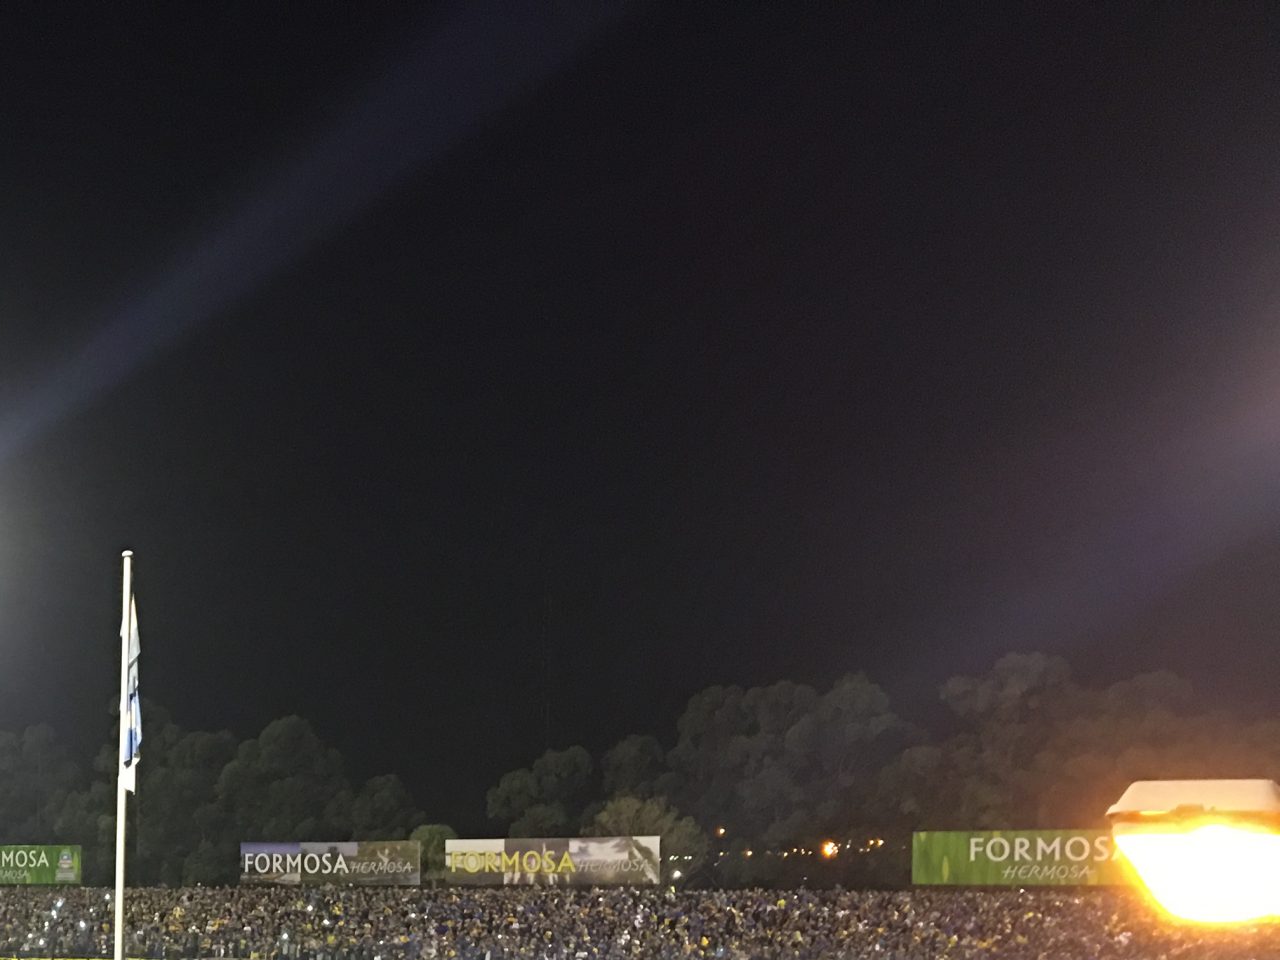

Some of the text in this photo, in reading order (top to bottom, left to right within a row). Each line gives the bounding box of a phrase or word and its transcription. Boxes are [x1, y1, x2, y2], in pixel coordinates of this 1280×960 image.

[244, 852, 413, 875] FORMOSA HERMOSA
[451, 850, 576, 874] FORMOSA
[1001, 864, 1096, 881] HERMOSA
